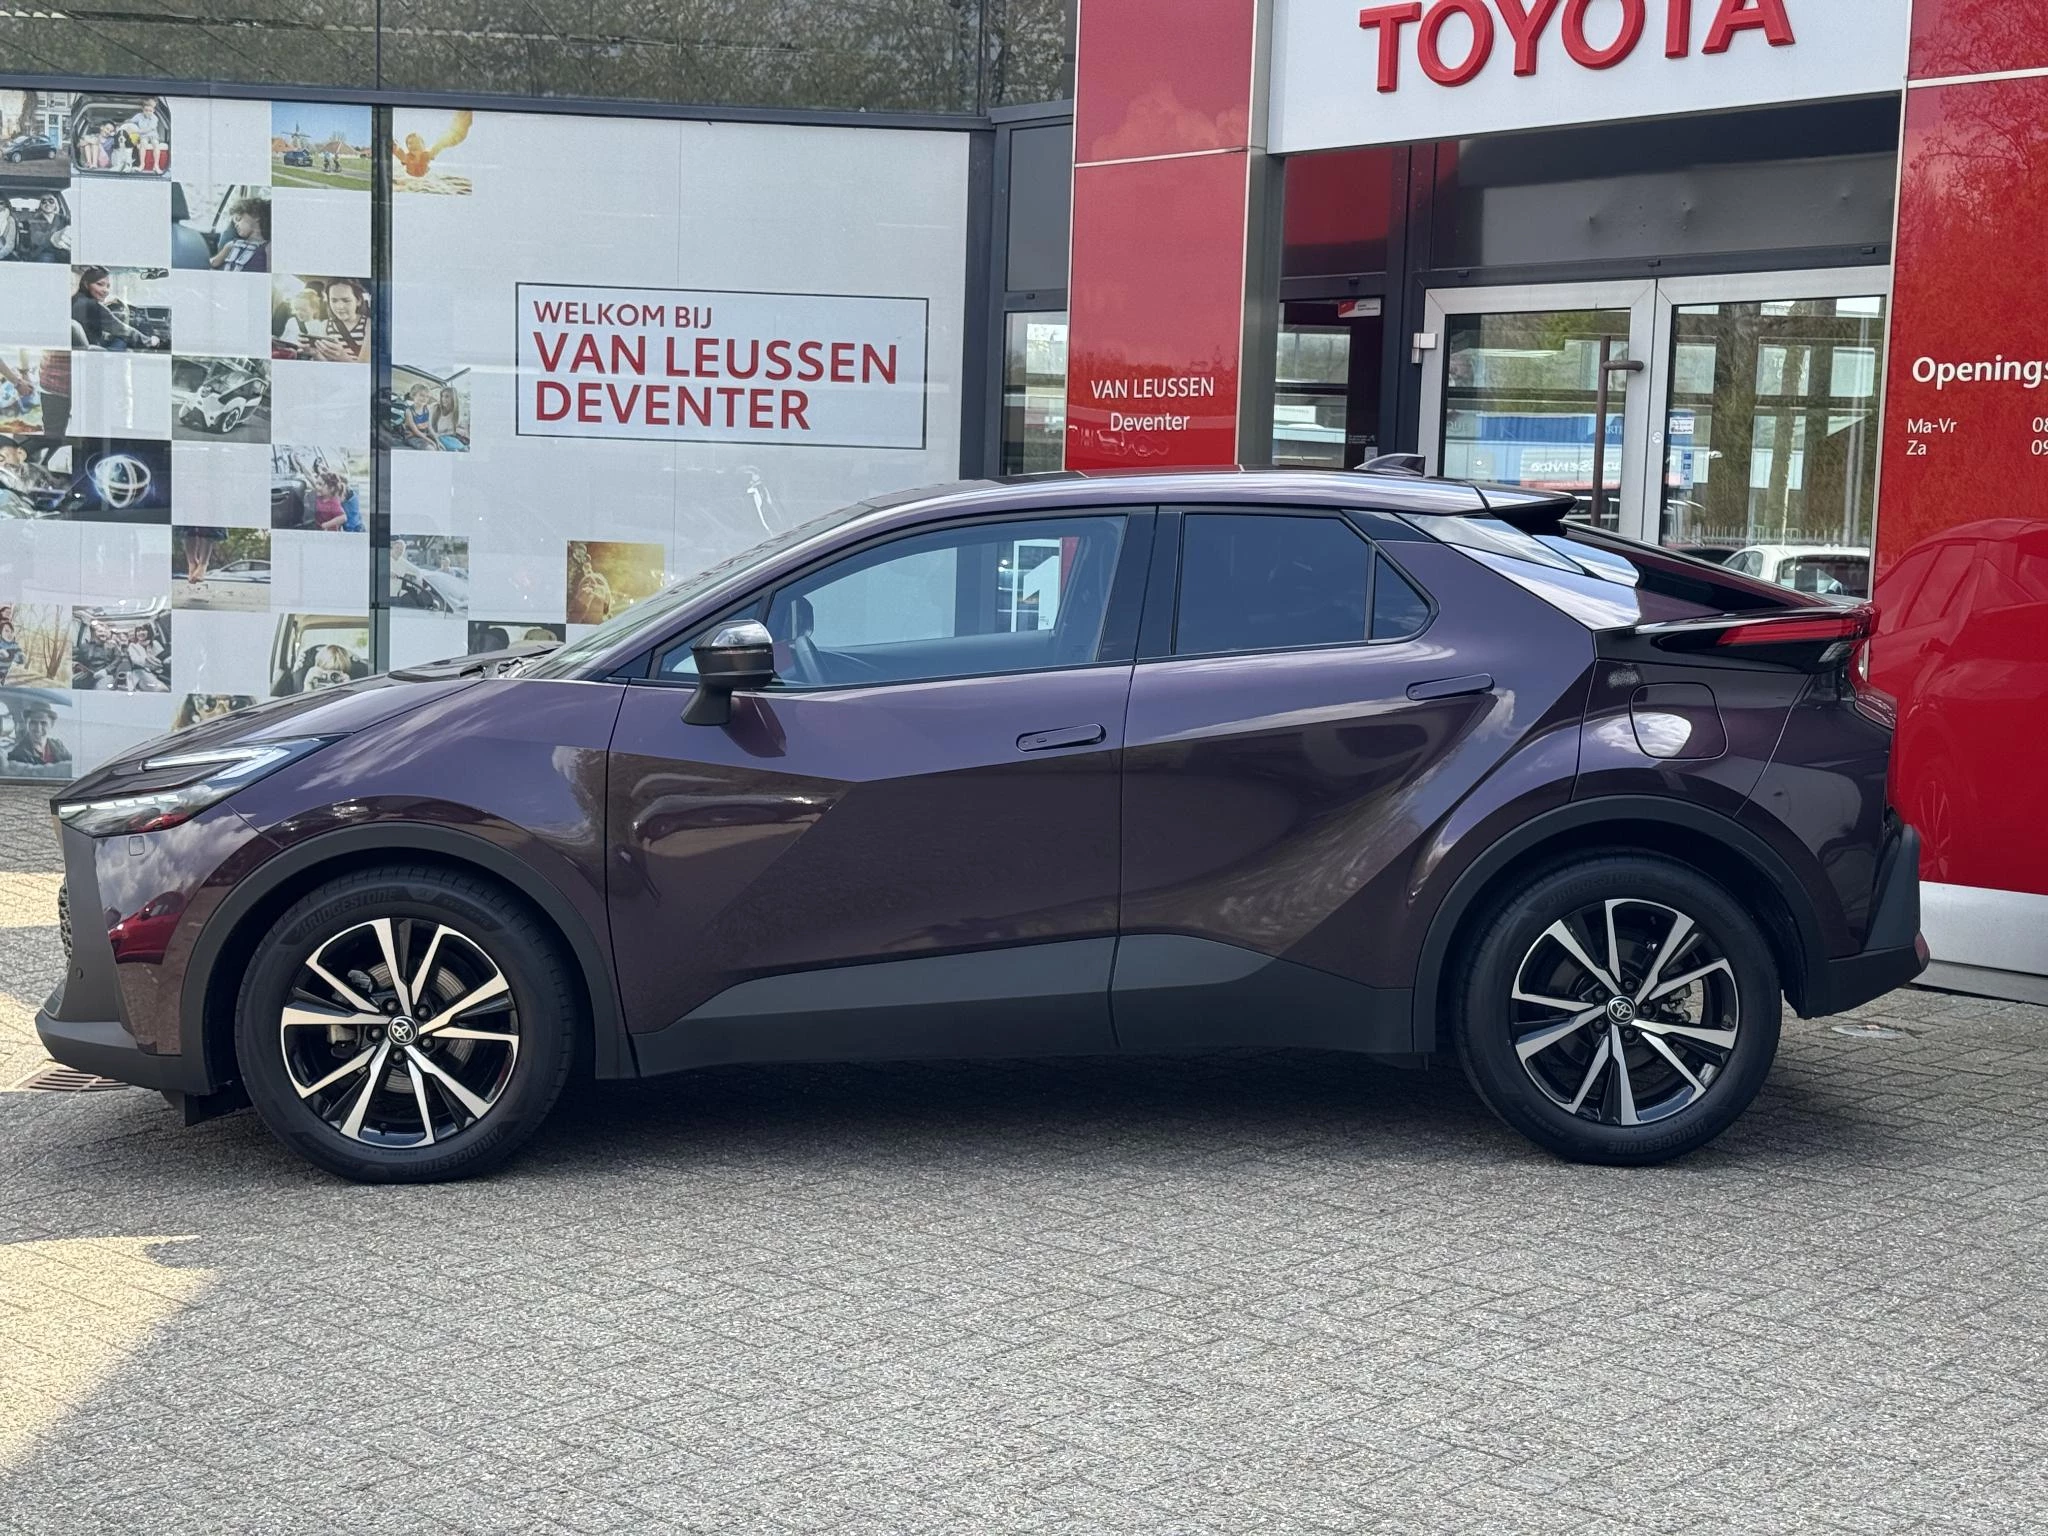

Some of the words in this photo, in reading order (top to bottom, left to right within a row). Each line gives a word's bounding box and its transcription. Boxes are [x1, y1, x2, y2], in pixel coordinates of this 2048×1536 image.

[533, 300, 665, 328] WELKOM
[674, 306, 713, 330] BIJ
[533, 332, 646, 376] VAN
[665, 336, 897, 385] LEUSSEN
[1091, 379, 1128, 399] VAN
[1133, 377, 1214, 399] LEUSSEN
[535, 381, 811, 431] DEVENTER
[1110, 412, 1190, 432] Deventer
[1907, 418, 1957, 434] Ma-Vr
[1906, 440, 1927, 456] Za
